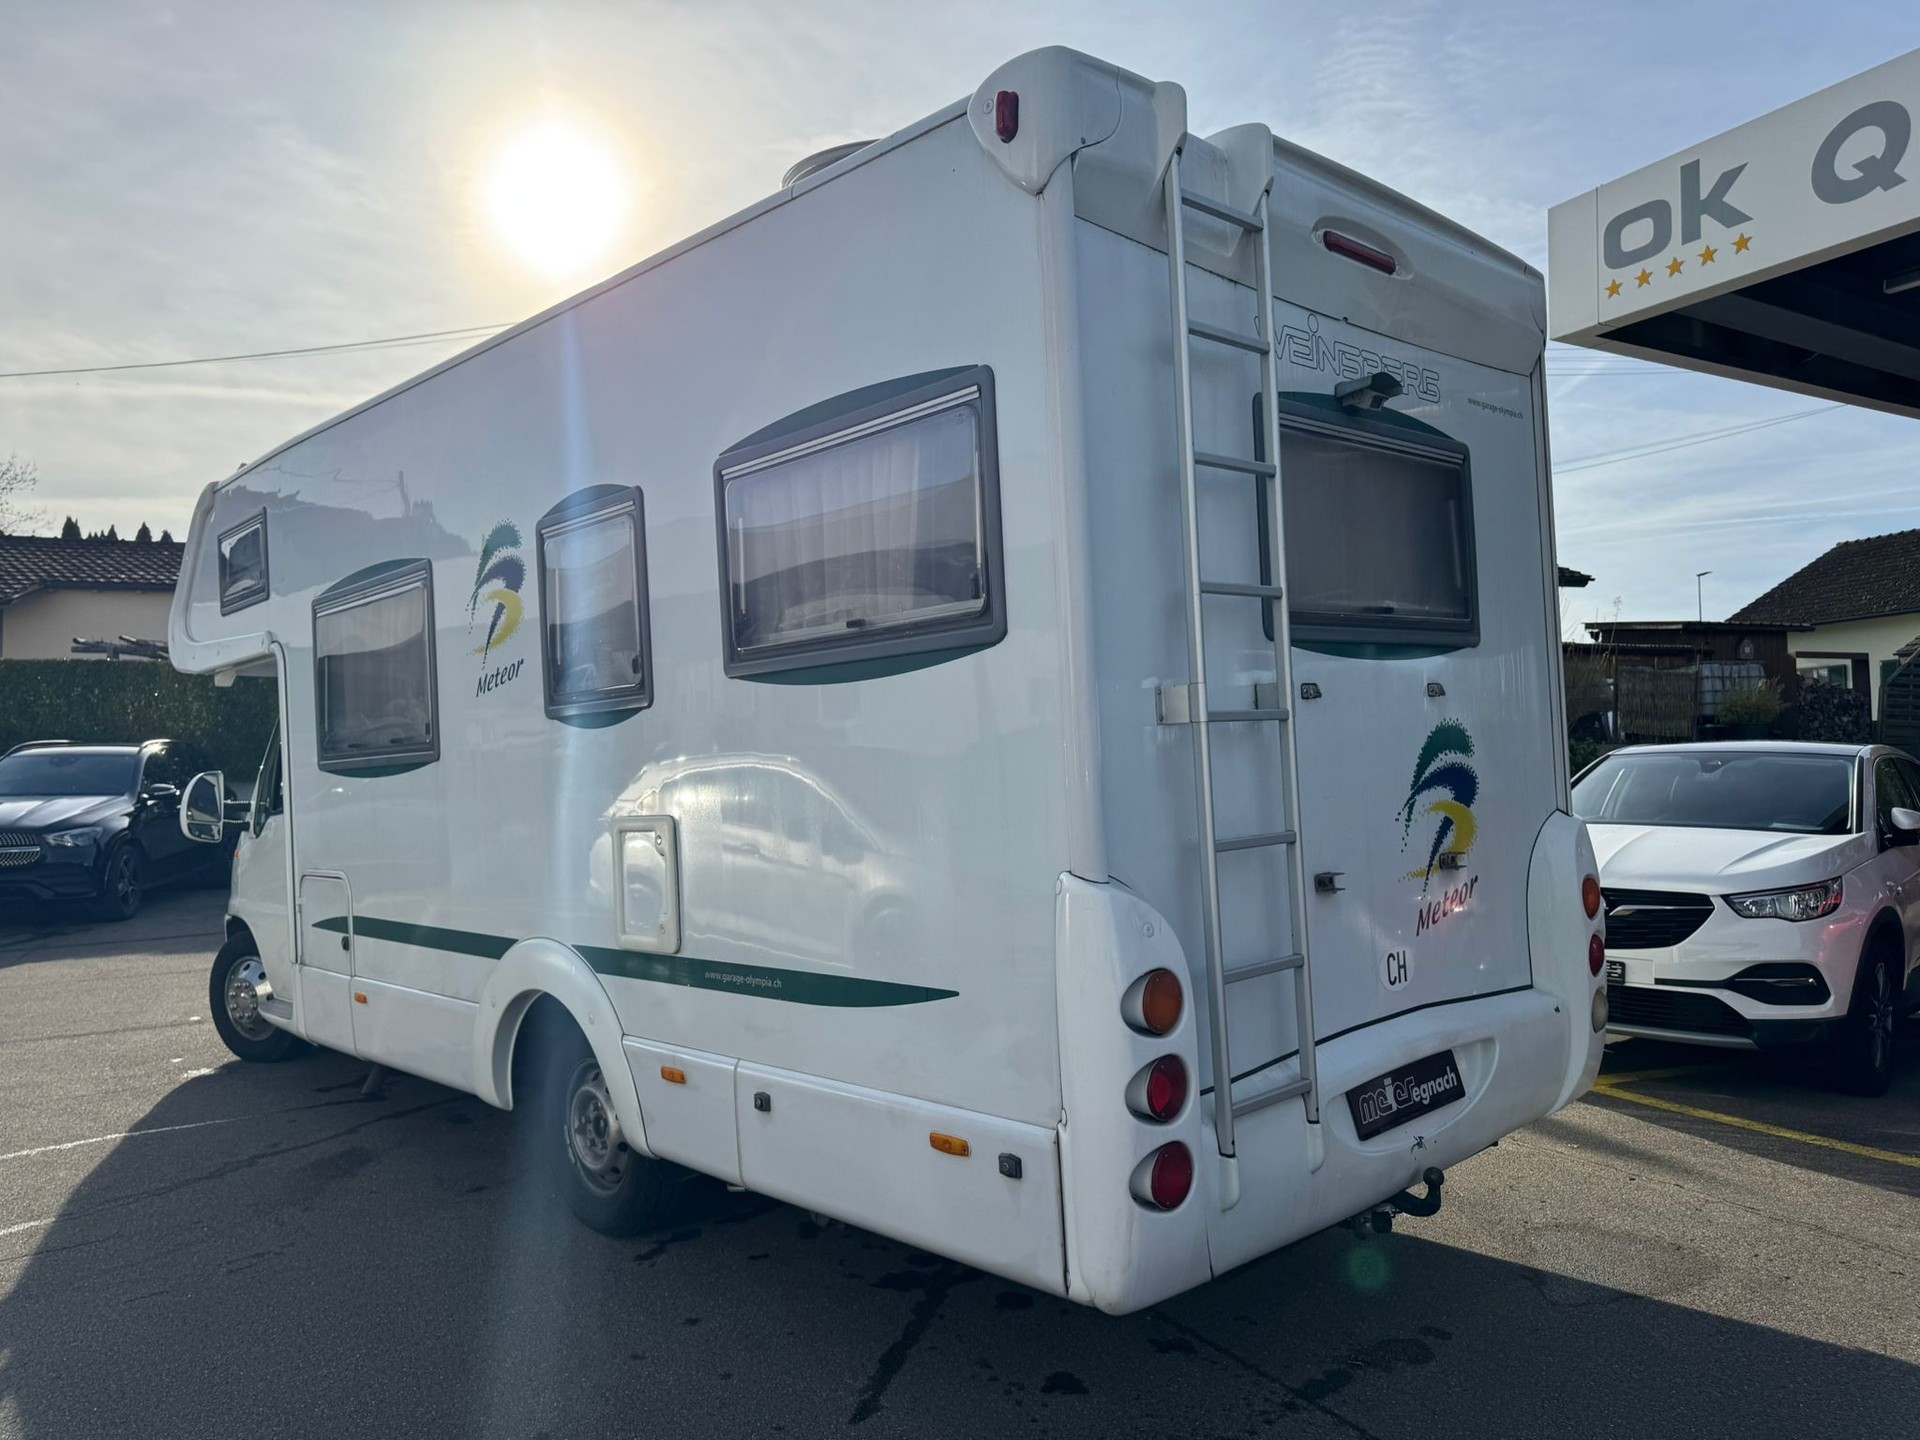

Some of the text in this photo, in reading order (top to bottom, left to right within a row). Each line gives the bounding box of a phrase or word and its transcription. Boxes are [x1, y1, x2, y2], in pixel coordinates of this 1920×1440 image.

[1811, 100, 1912, 205] Q
[476, 658, 524, 697] Meteor
[1416, 875, 1478, 937] Meteor
[705, 971, 782, 988] www.garage-olympia.ch
[1387, 950, 1407, 985] CH
